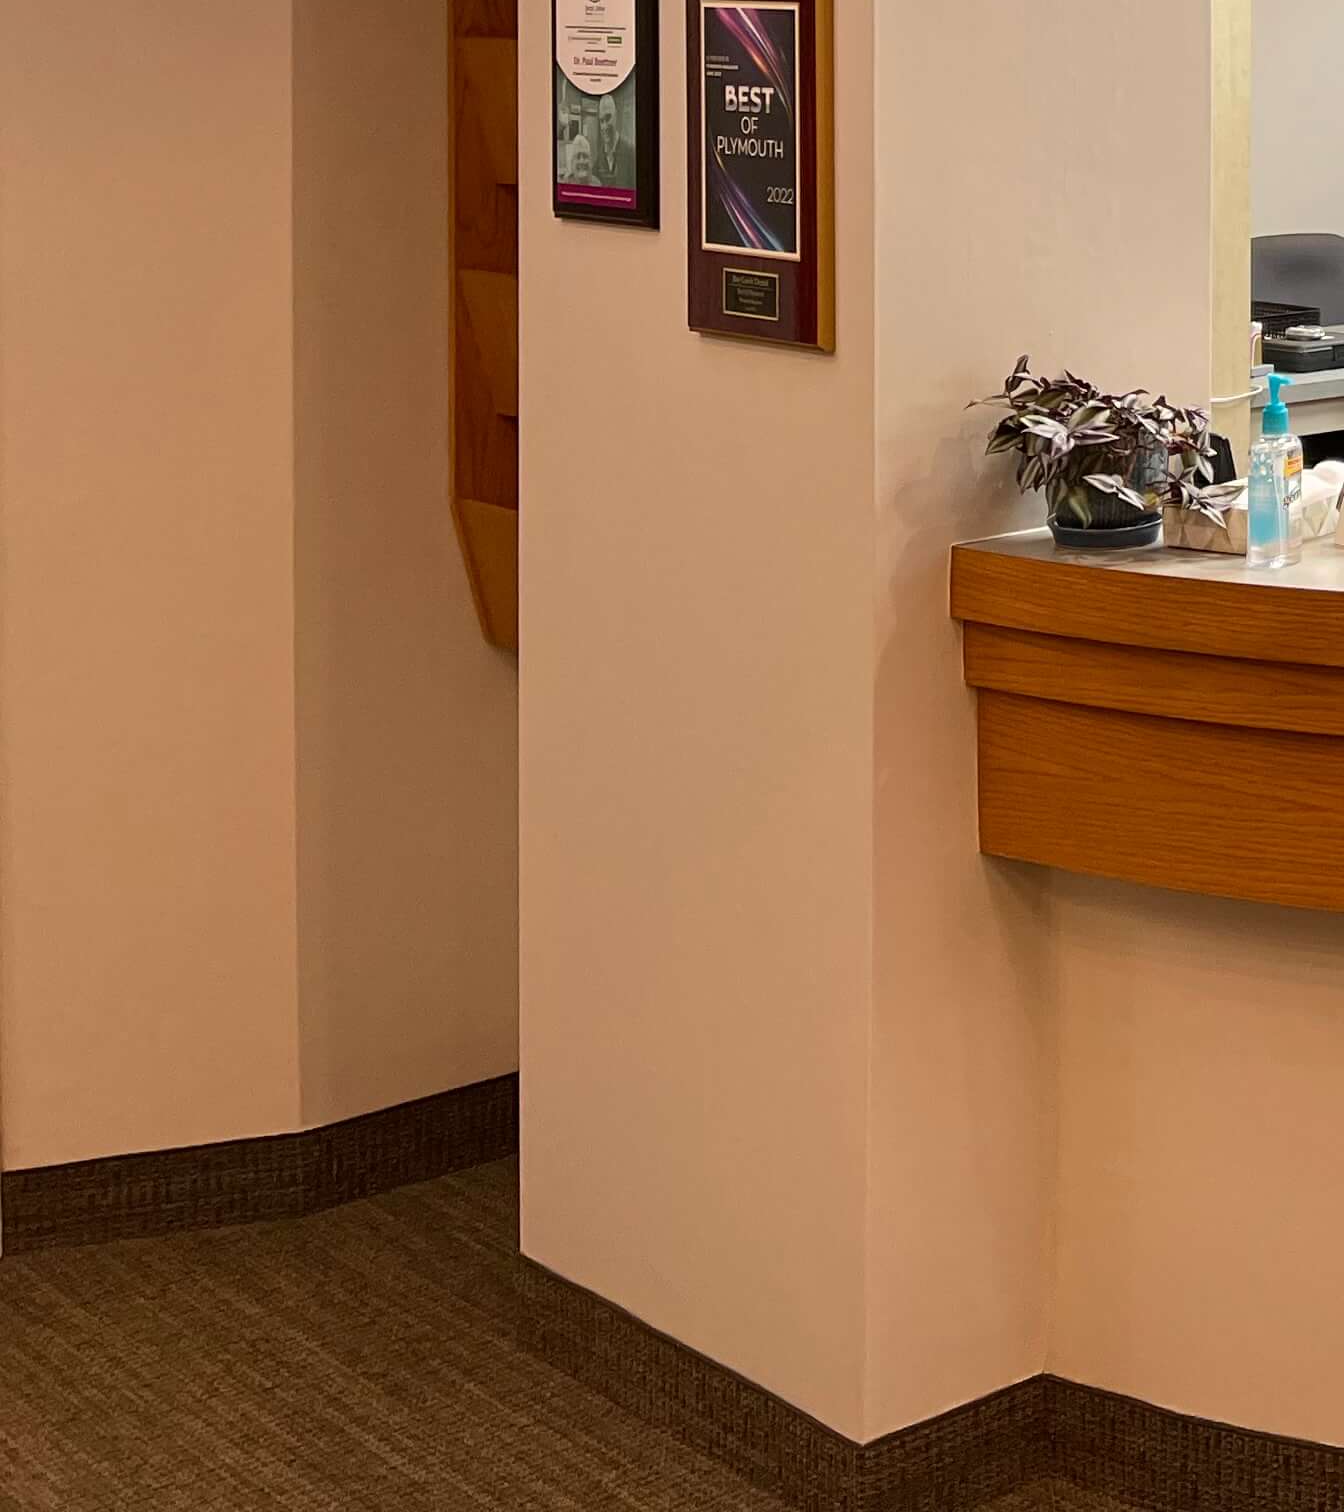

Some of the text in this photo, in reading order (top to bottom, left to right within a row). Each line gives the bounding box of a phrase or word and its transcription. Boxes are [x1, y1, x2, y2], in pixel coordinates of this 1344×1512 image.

[725, 85, 774, 114] BEST
[741, 116, 759, 134] OF
[717, 135, 784, 159] PLYMOUTH
[767, 186, 794, 204] 2022
